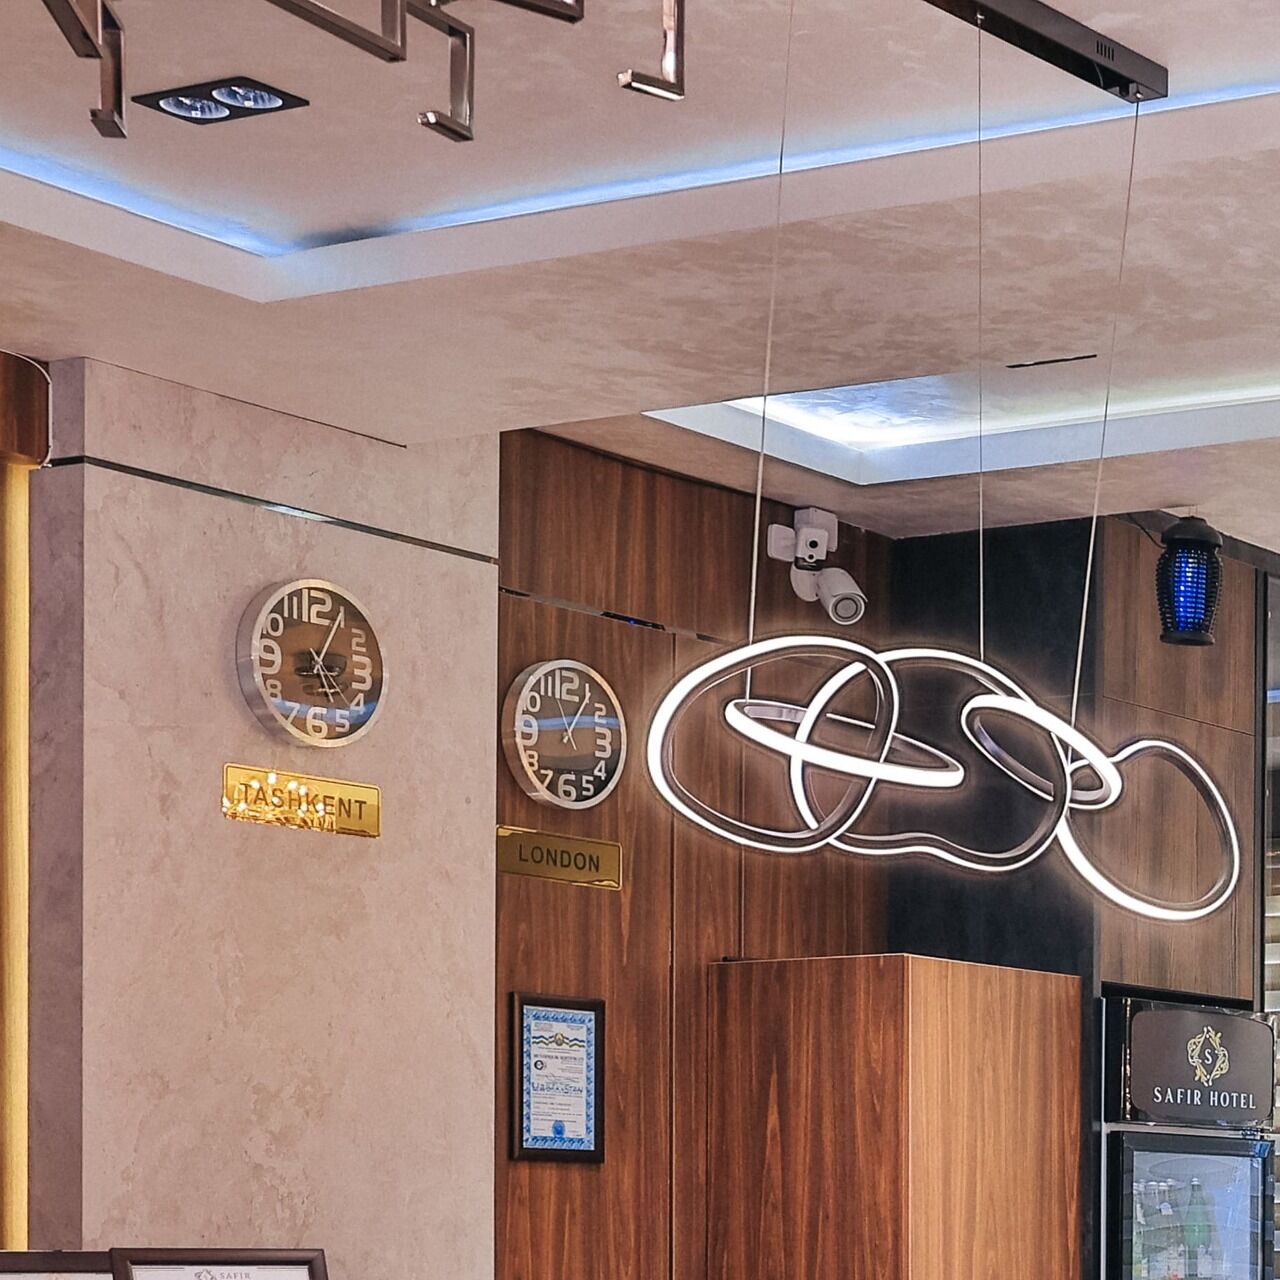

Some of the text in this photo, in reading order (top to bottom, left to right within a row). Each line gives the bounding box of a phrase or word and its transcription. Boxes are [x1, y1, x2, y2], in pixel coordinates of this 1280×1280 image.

[301, 588, 333, 627] 12
[351, 654, 373, 691] 3
[554, 669, 580, 703] 12
[306, 706, 329, 739] 6
[594, 726, 612, 759] 3
[240, 782, 367, 821] TASHKENT
[557, 773, 577, 802] 6
[518, 843, 600, 873] LONDON
[1153, 1086, 1257, 1109] SAFIR HOTEL
